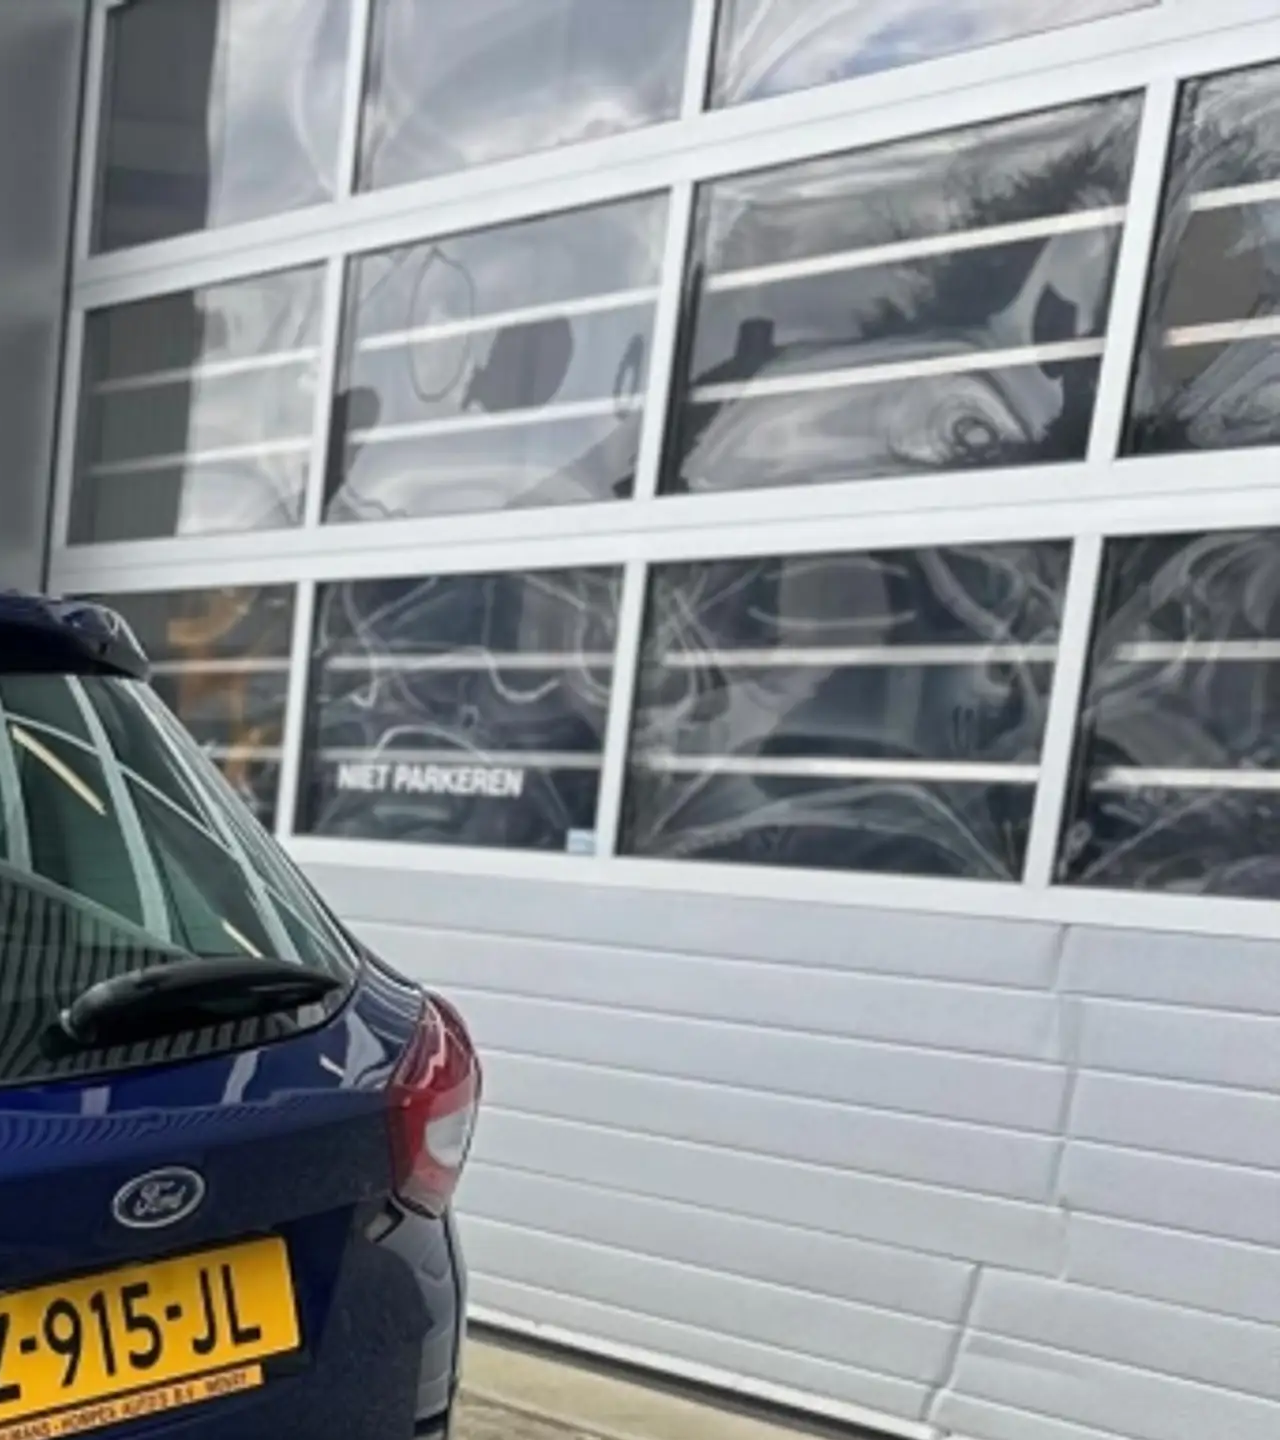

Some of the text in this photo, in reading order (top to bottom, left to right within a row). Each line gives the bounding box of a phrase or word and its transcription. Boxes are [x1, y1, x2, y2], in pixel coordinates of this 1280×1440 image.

[336, 762, 524, 798] NIET PARKEREN
[133, 1180, 187, 1217] Ford
